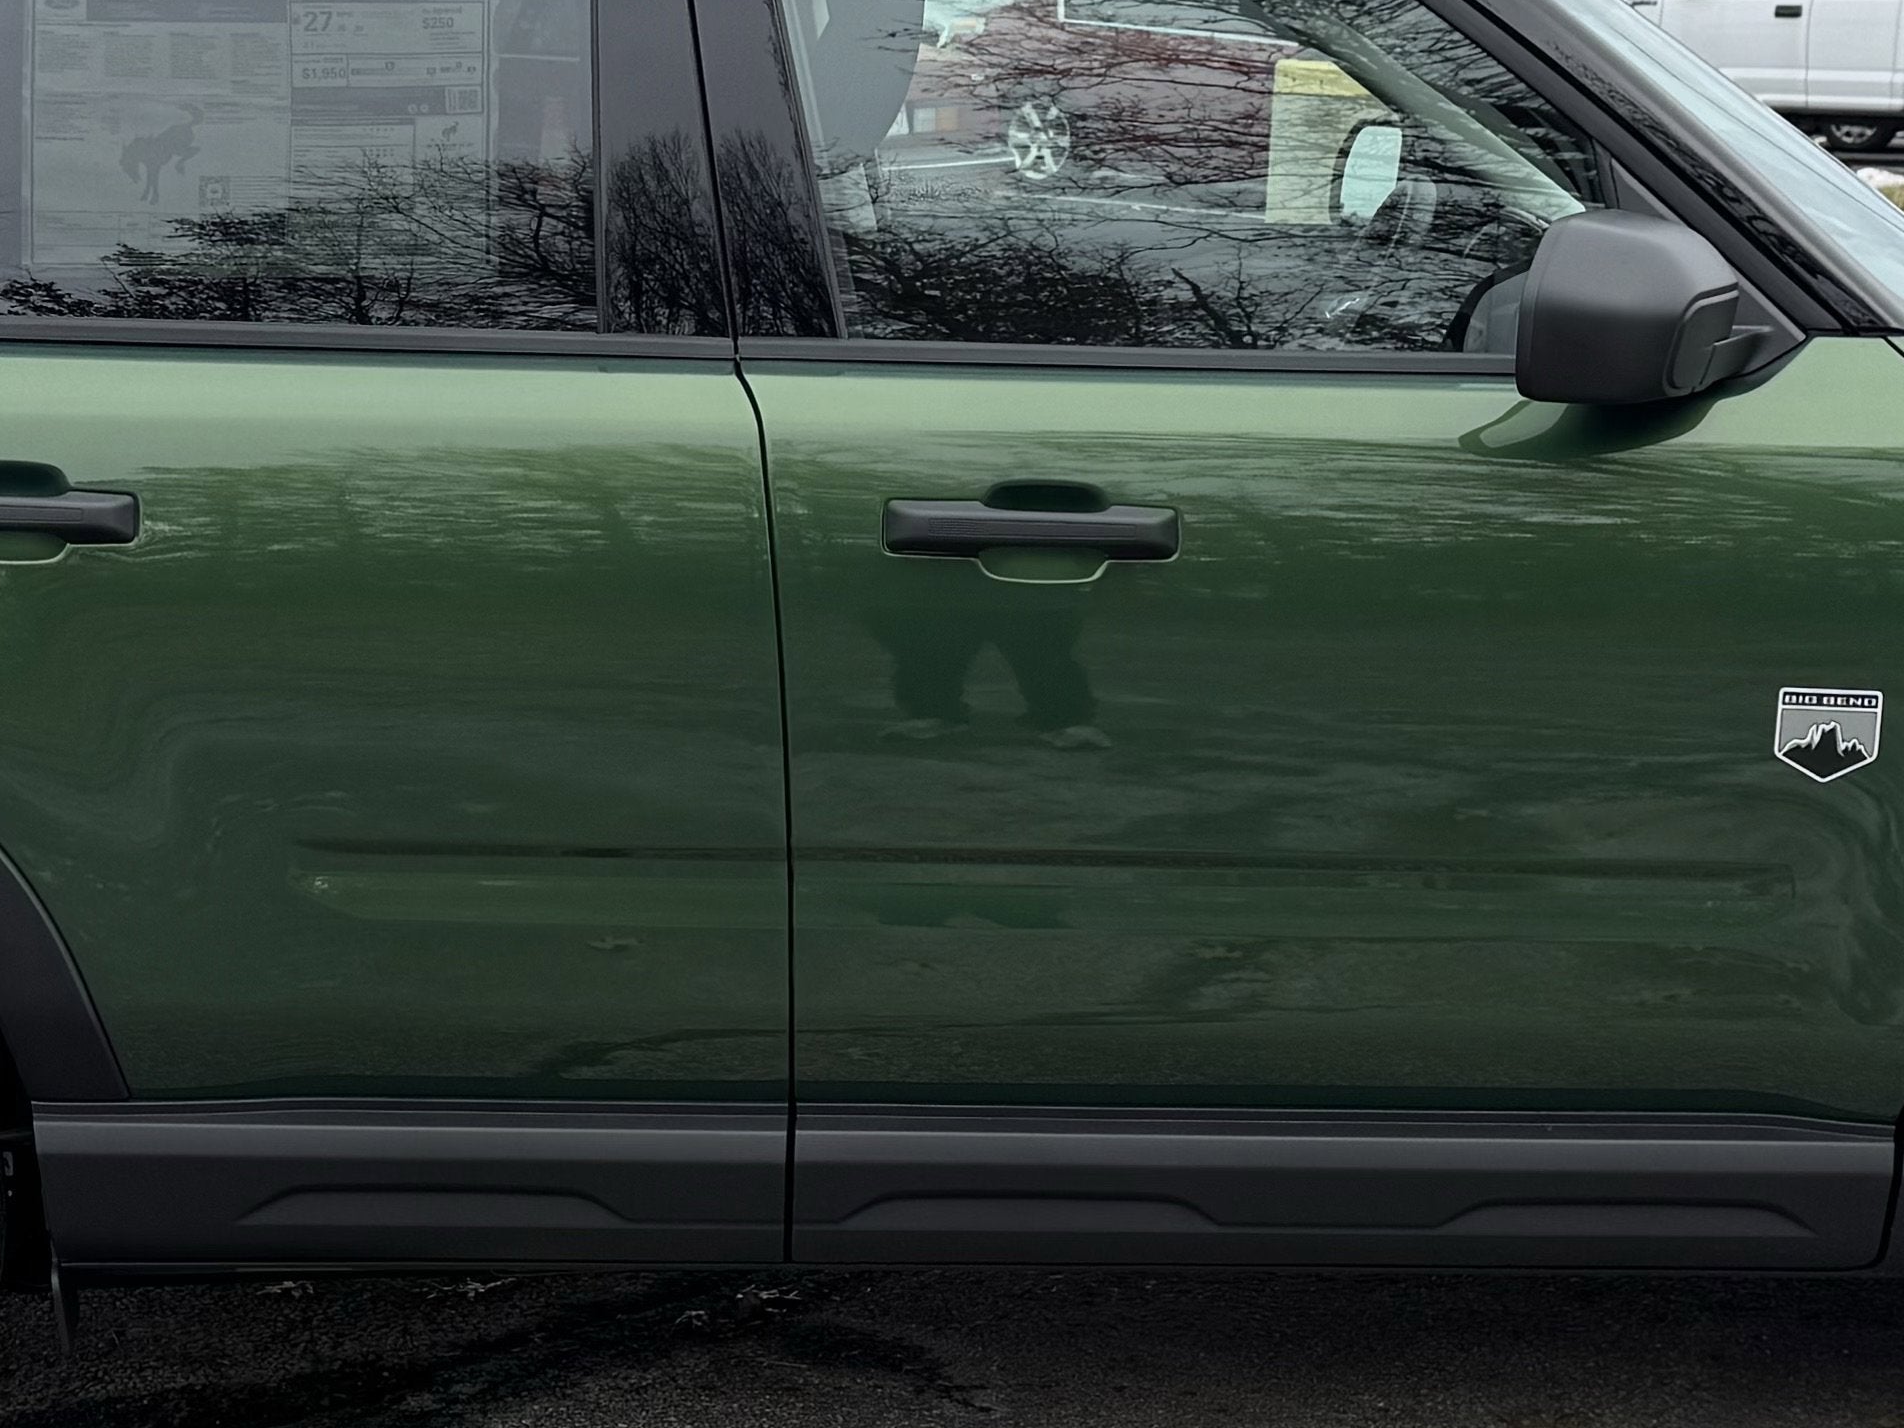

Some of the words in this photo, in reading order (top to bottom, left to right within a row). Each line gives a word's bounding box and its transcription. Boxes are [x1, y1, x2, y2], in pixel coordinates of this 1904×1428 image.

[302, 11, 332, 32] 27
[422, 16, 455, 30] $250
[1784, 694, 1817, 705] BIG
[1822, 696, 1877, 707] BEND
